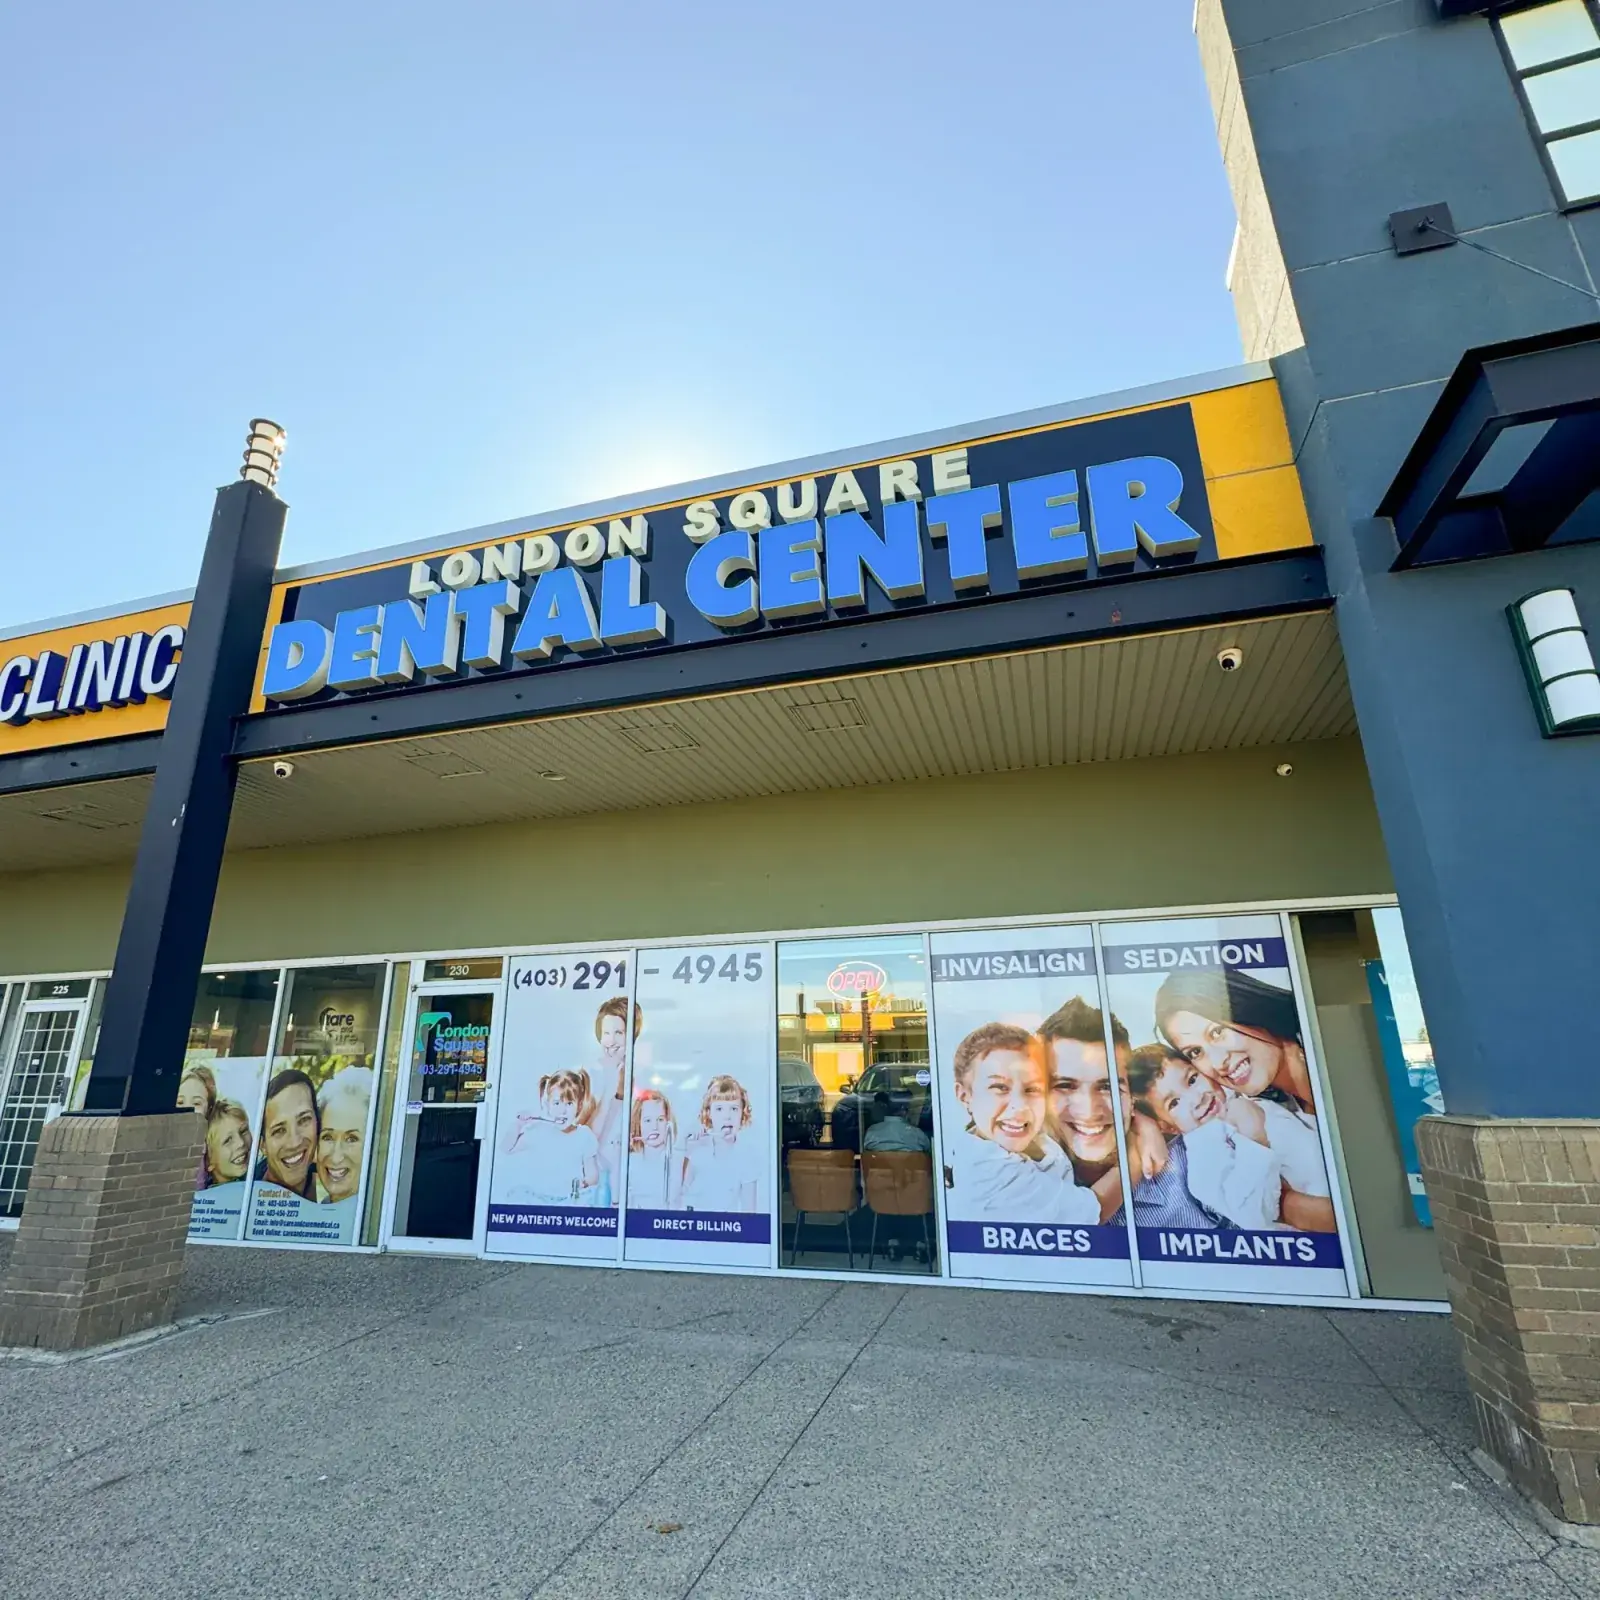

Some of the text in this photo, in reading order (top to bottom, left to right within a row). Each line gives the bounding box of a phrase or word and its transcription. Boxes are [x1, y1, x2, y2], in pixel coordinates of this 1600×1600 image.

[409, 448, 971, 598] LONDON SQUARE
[262, 456, 1201, 700] DENTAL CENTER
[0, 624, 186, 724] CLINIC
[941, 952, 1086, 977] INVISALIGN
[1124, 943, 1265, 969] SEDATION
[449, 965, 470, 976] 230
[513, 966, 567, 989] (403)
[572, 959, 626, 990] 291
[672, 952, 763, 984] 4945
[830, 970, 881, 992] OPEN
[52, 985, 69, 995] 225
[436, 1023, 489, 1038] London
[434, 1037, 486, 1052] Square
[258, 1188, 281, 1198] Contact
[491, 1213, 617, 1228] NEW PATIENTS WELCOME
[653, 1217, 742, 1232] DIRECT BILLING
[982, 1226, 1091, 1252] BRACES
[1160, 1232, 1316, 1262] IMPLANTS
